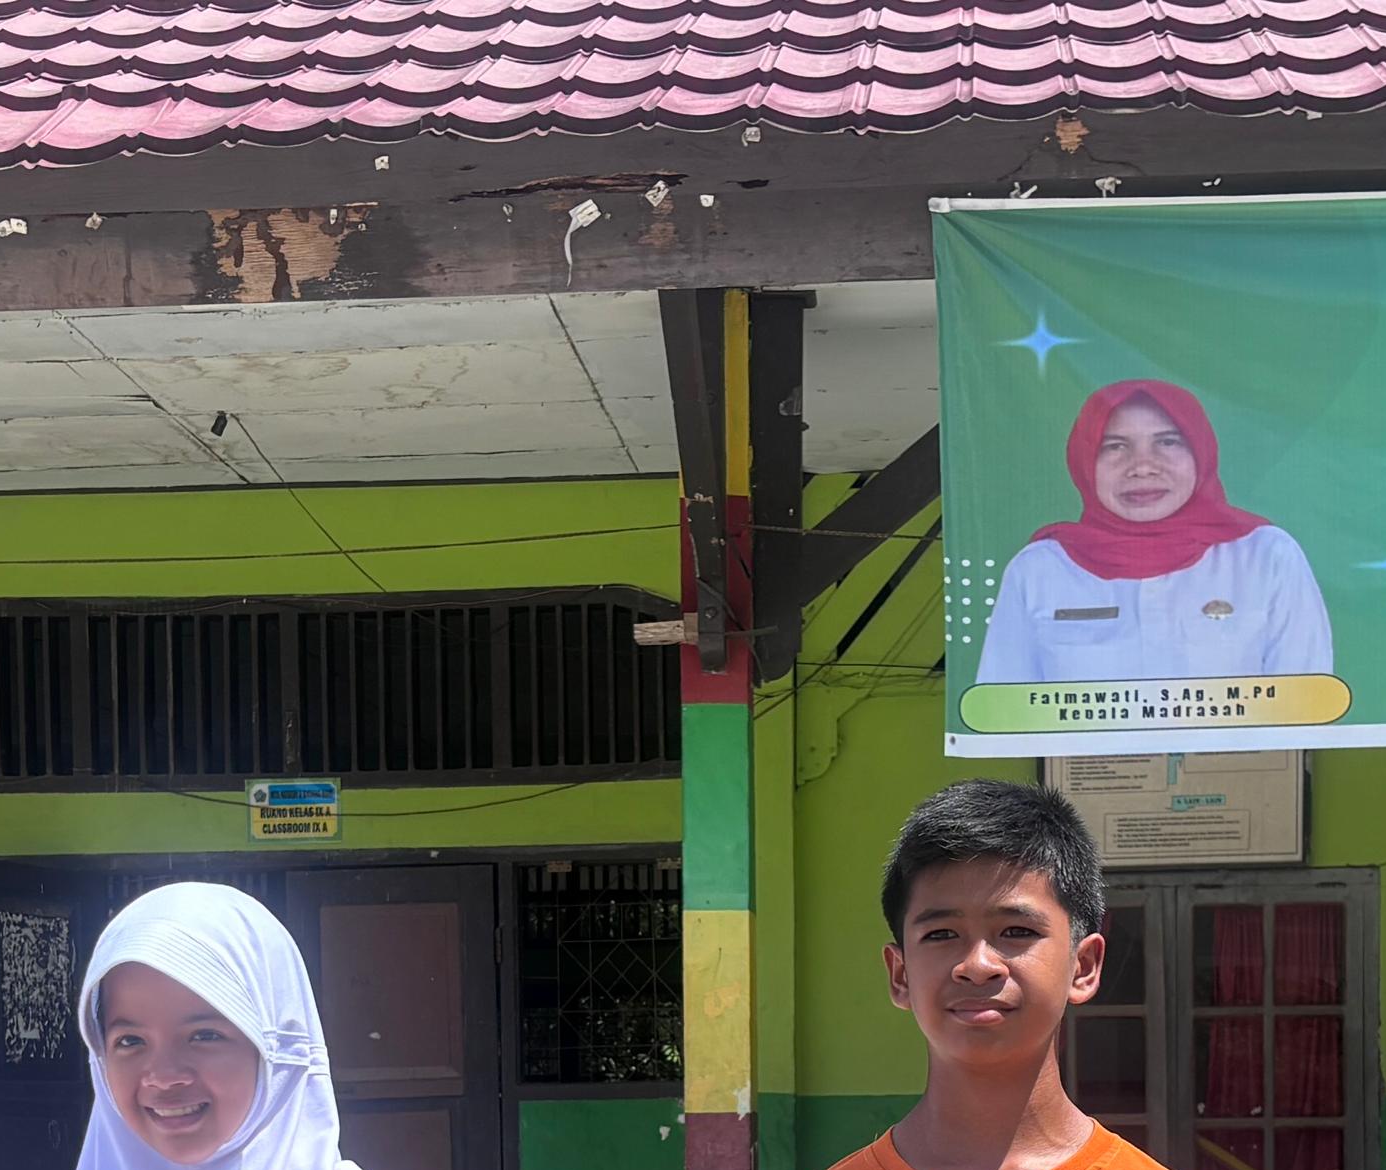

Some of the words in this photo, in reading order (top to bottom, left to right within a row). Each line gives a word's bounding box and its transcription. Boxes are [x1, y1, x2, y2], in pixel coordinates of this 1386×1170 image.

[1226, 684, 1277, 700] M.Pd
[1059, 706, 1130, 721] Kepala
[1142, 703, 1246, 719] Madrasah
[289, 806, 315, 818] KELAS
[325, 806, 332, 817] A
[262, 823, 311, 834] CLASSROOM
[322, 821, 328, 833] A
